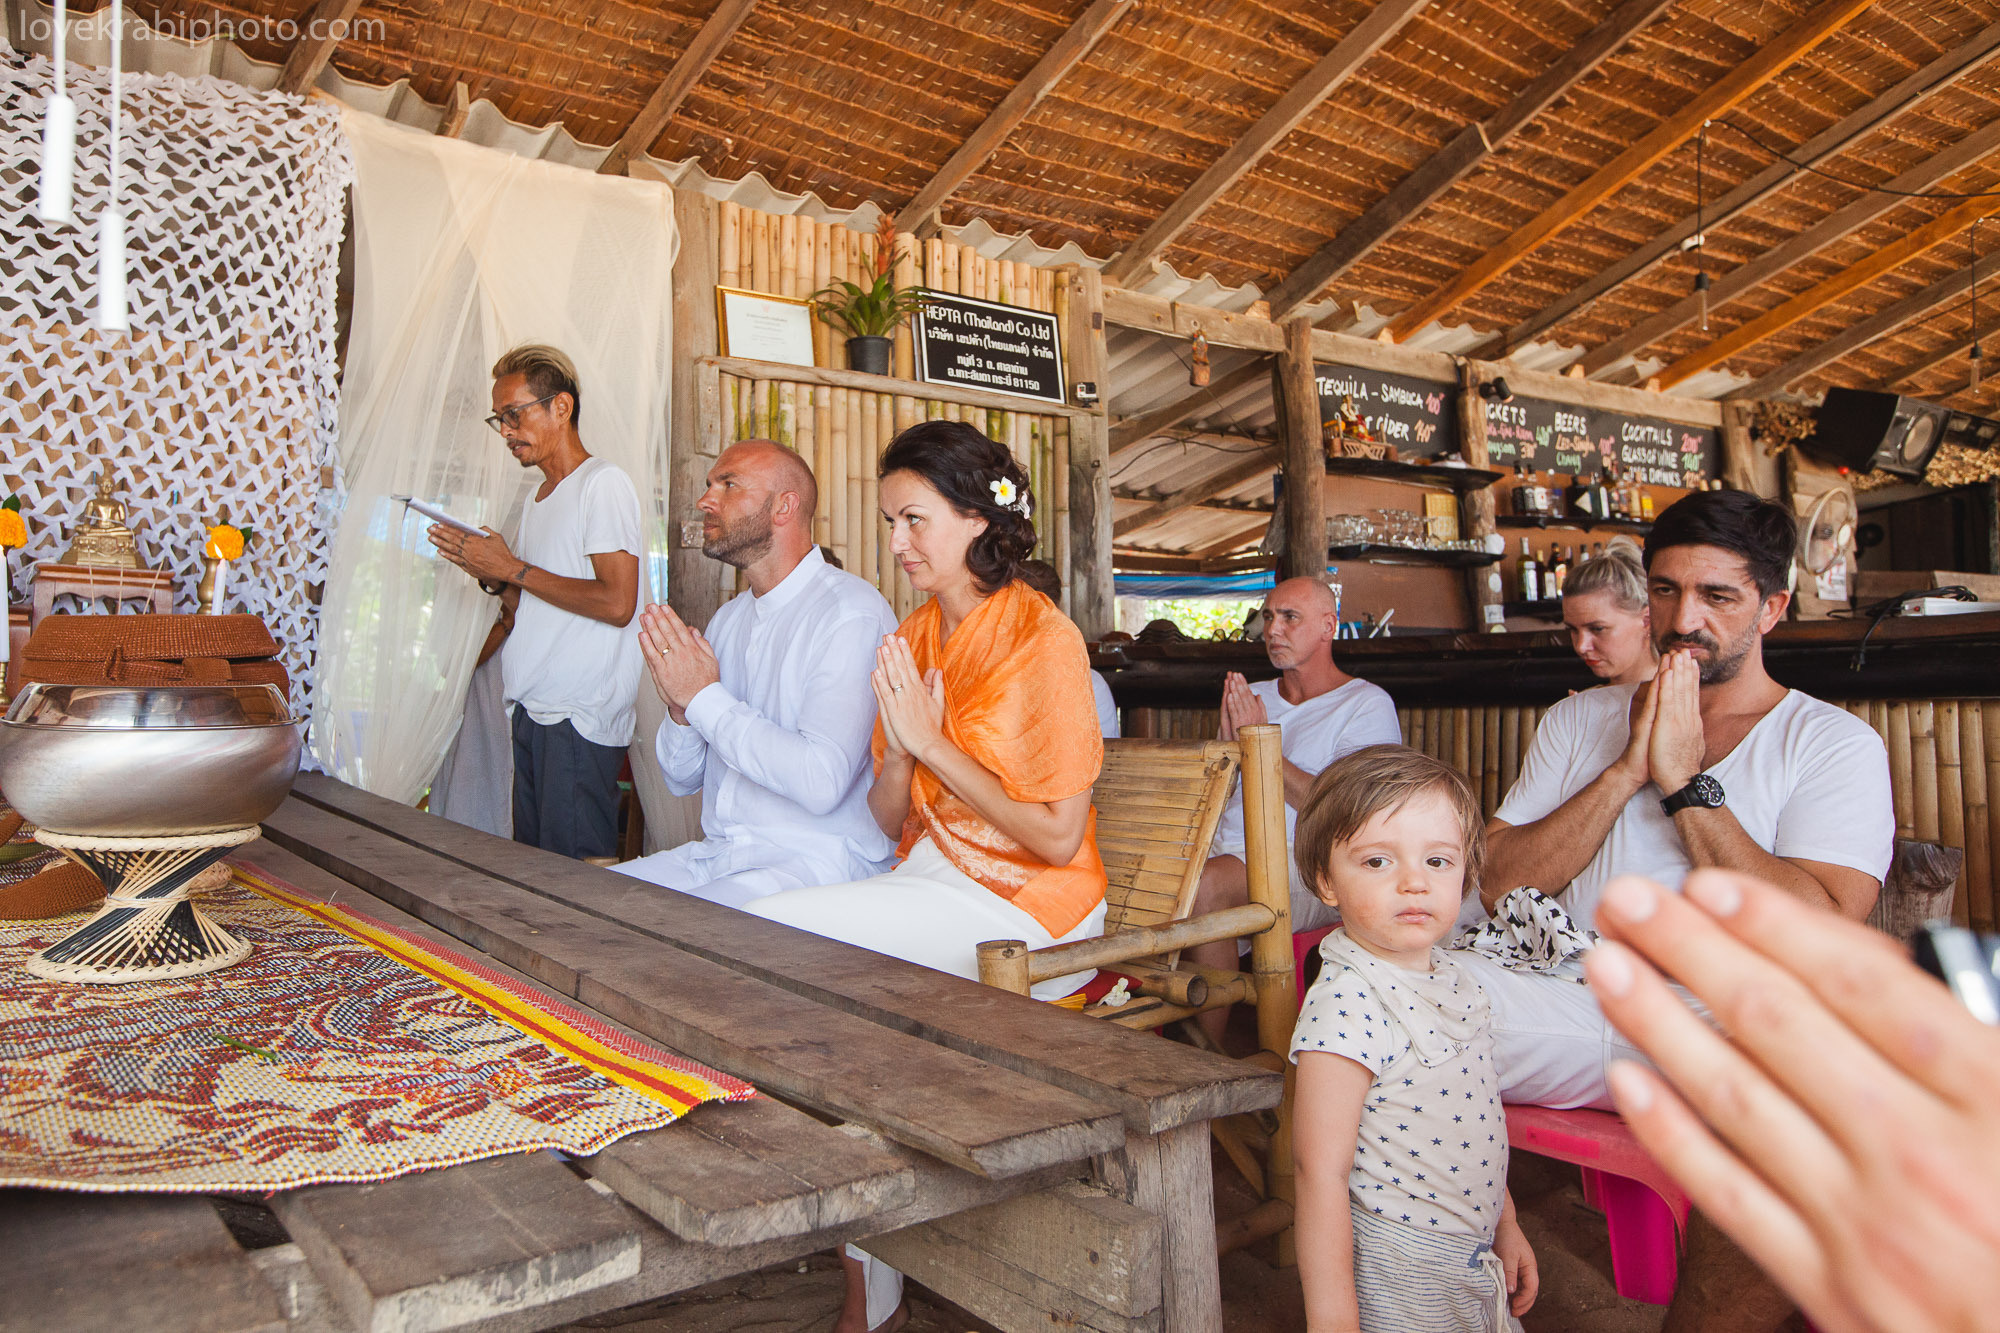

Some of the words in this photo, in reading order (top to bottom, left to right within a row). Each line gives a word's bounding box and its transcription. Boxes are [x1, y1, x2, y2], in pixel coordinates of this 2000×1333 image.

[926, 304, 962, 324] HEPTA
[963, 311, 1015, 334] (Thailand)
[927, 326, 954, 342] บริษัท
[1031, 345, 1054, 360] จำกัด
[976, 357, 983, 368] 3
[1012, 378, 1041, 391] 81150
[1381, 383, 1424, 410] SAMBUCA
[1485, 403, 1527, 427] CKETS
[1555, 411, 1587, 436] BEERS
[1621, 421, 1673, 448] COCKTAILS
[1621, 444, 1647, 464] GLASS
[1656, 448, 1679, 470] WINE
